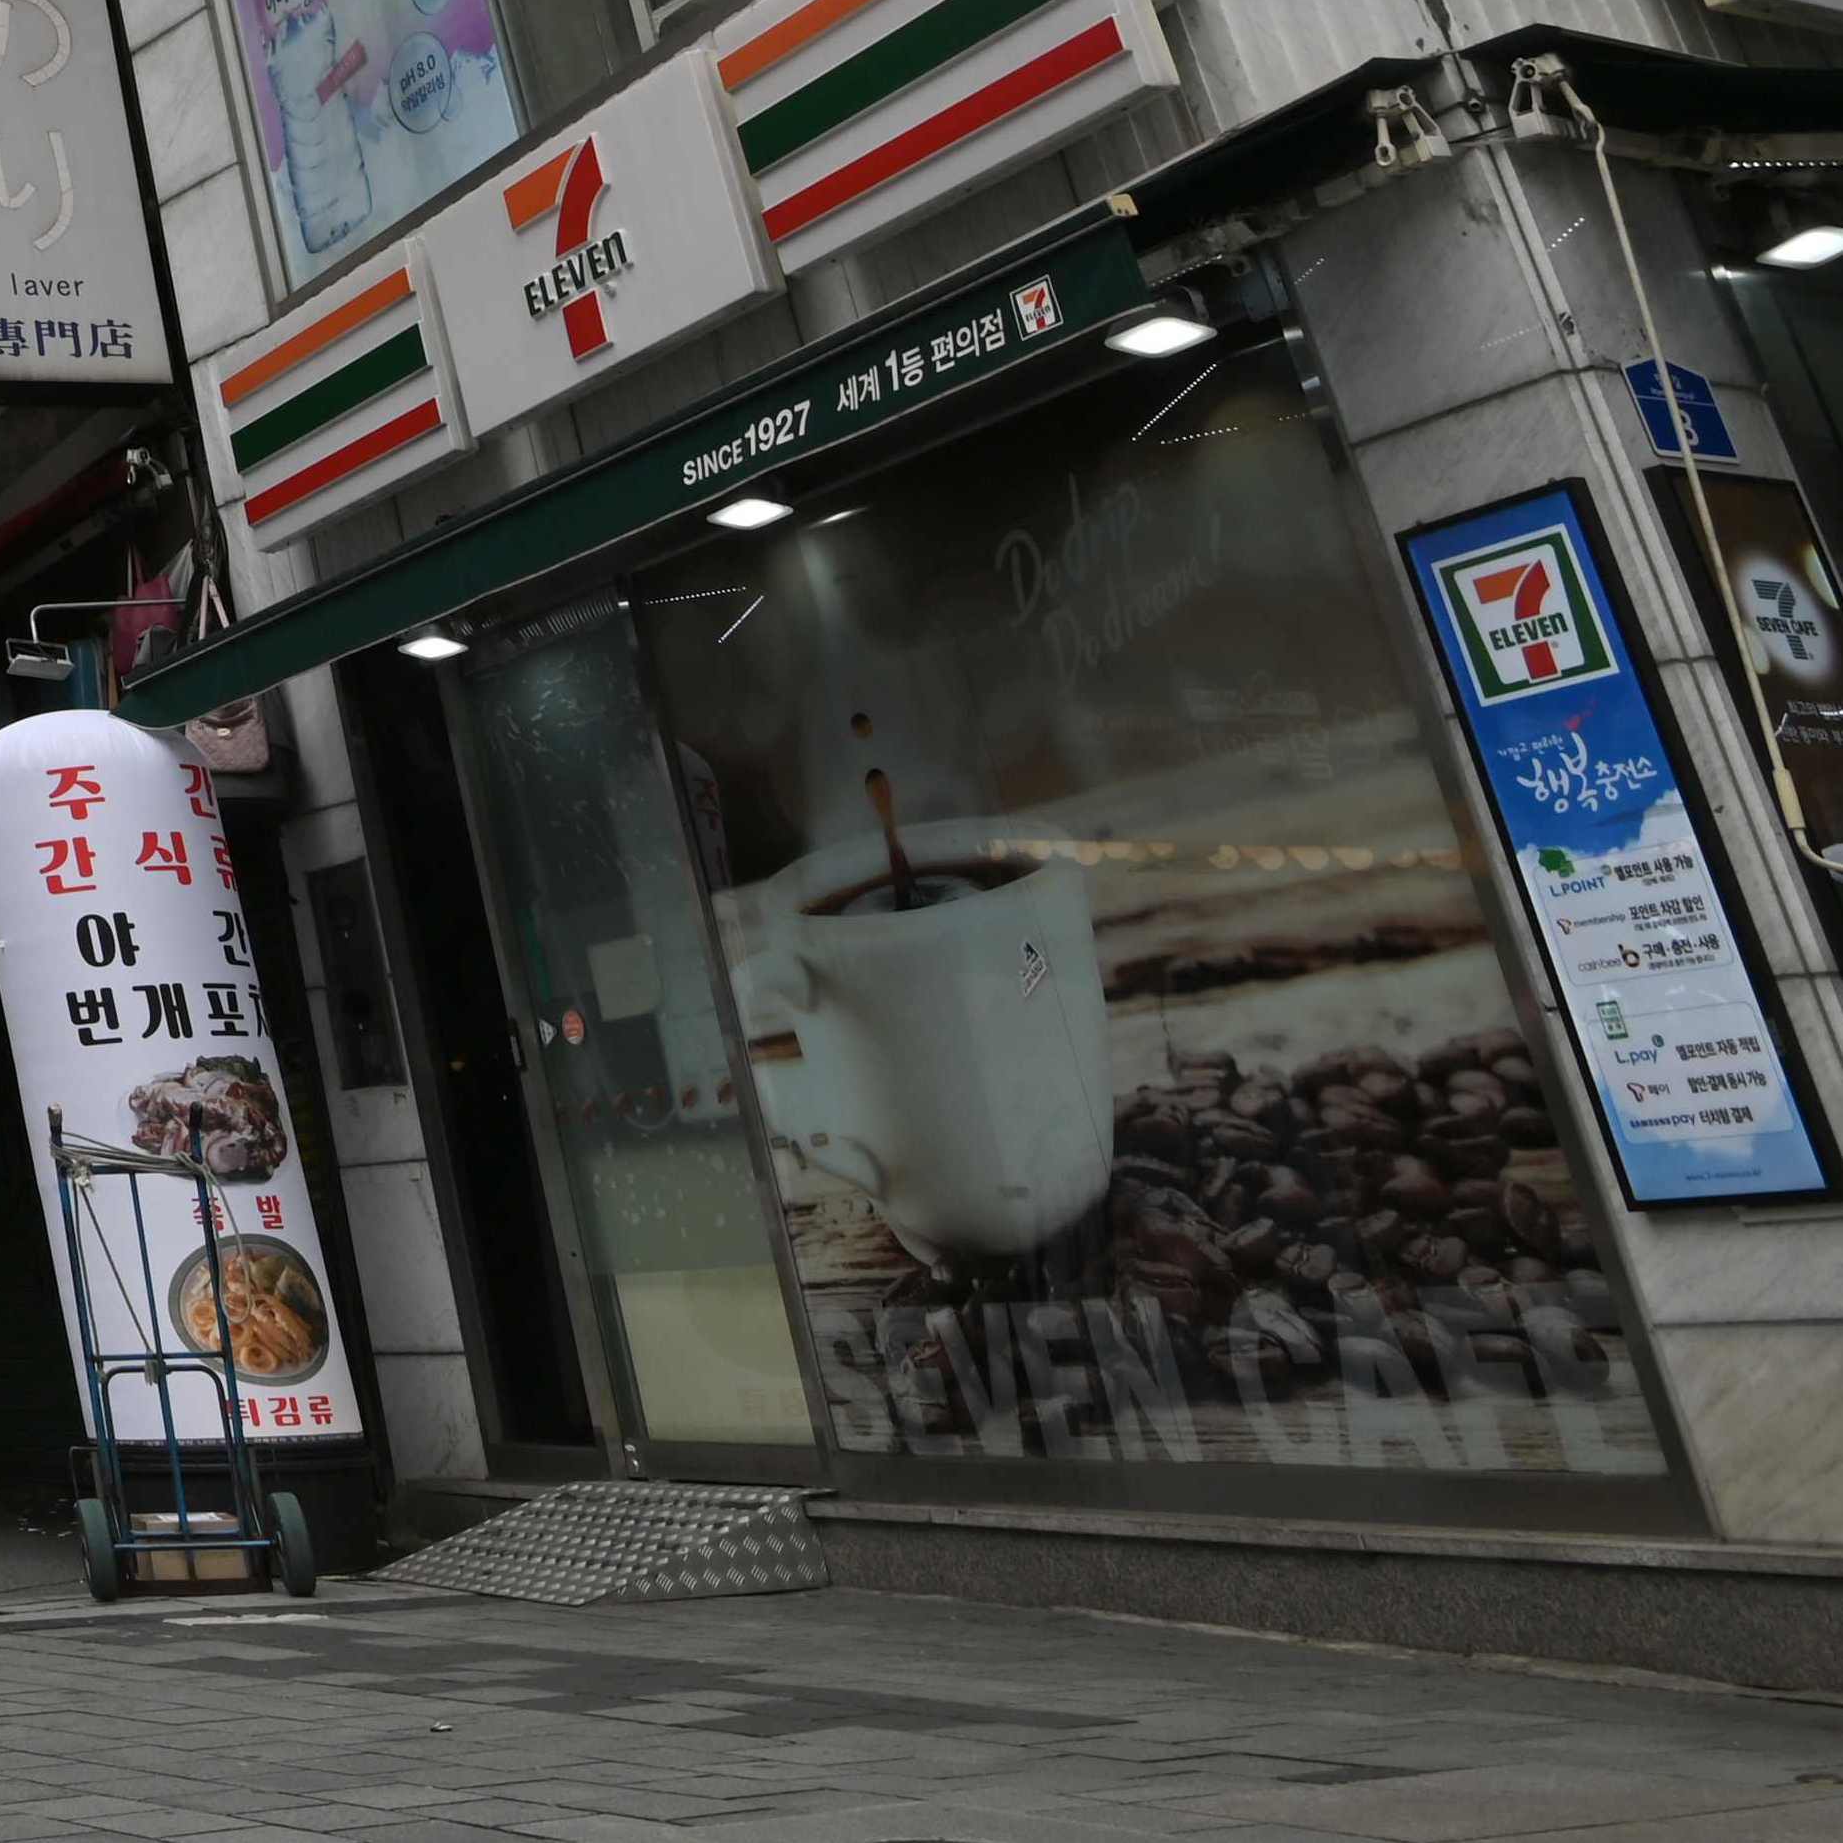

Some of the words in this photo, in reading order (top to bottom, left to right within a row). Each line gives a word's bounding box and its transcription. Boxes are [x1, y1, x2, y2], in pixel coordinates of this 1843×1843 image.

[9, 271, 86, 300] laver
[681, 436, 744, 487] SINCE
[743, 398, 812, 459] 1927
[835, 365, 882, 414] 세계
[884, 348, 927, 393] 1등
[930, 307, 1008, 372] 편의점
[1755, 615, 1790, 634] SEVEN
[1515, 730, 1600, 814] 행복
[1594, 755, 1659, 803] 충전소
